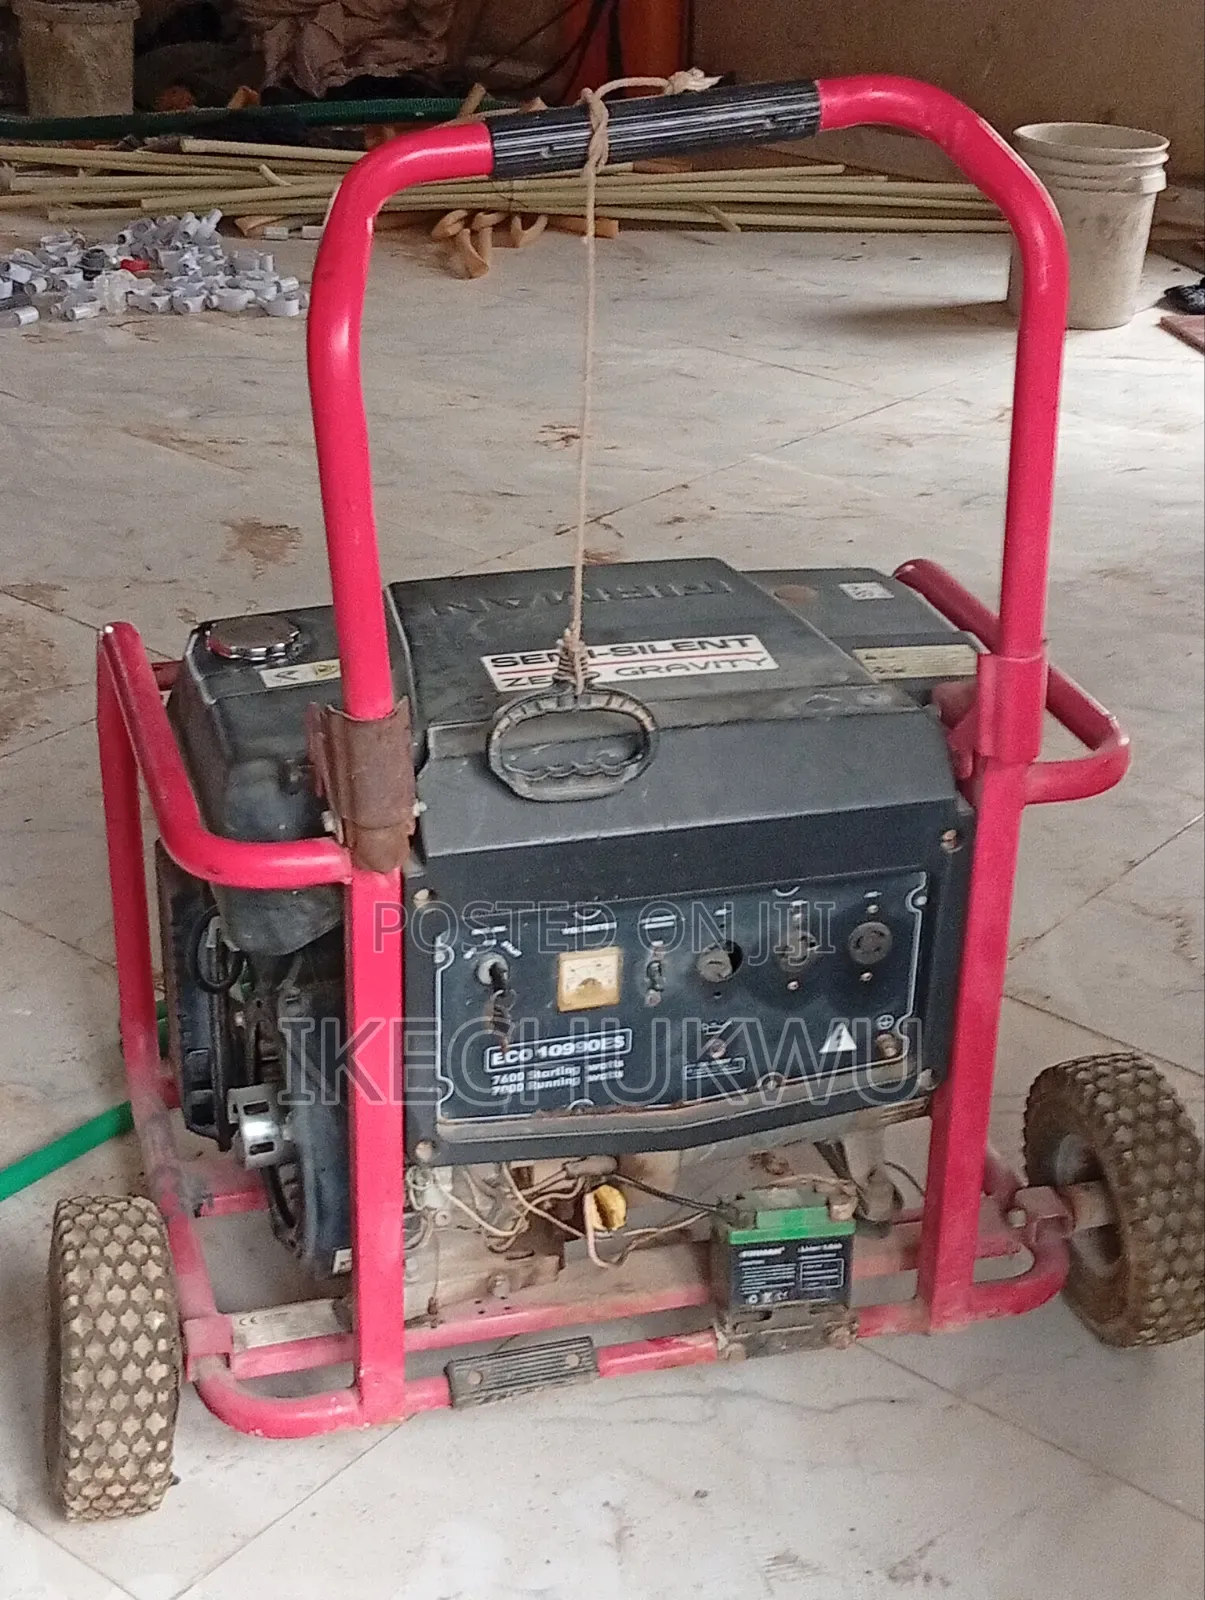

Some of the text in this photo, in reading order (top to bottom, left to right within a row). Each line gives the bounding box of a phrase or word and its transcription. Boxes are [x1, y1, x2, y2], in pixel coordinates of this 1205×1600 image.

[502, 656, 768, 688] ZEO GRAVITY
[490, 1048, 533, 1066] ECO
[491, 1060, 624, 1085] 7600 Starting watts
[527, 1075, 581, 1091] Running
